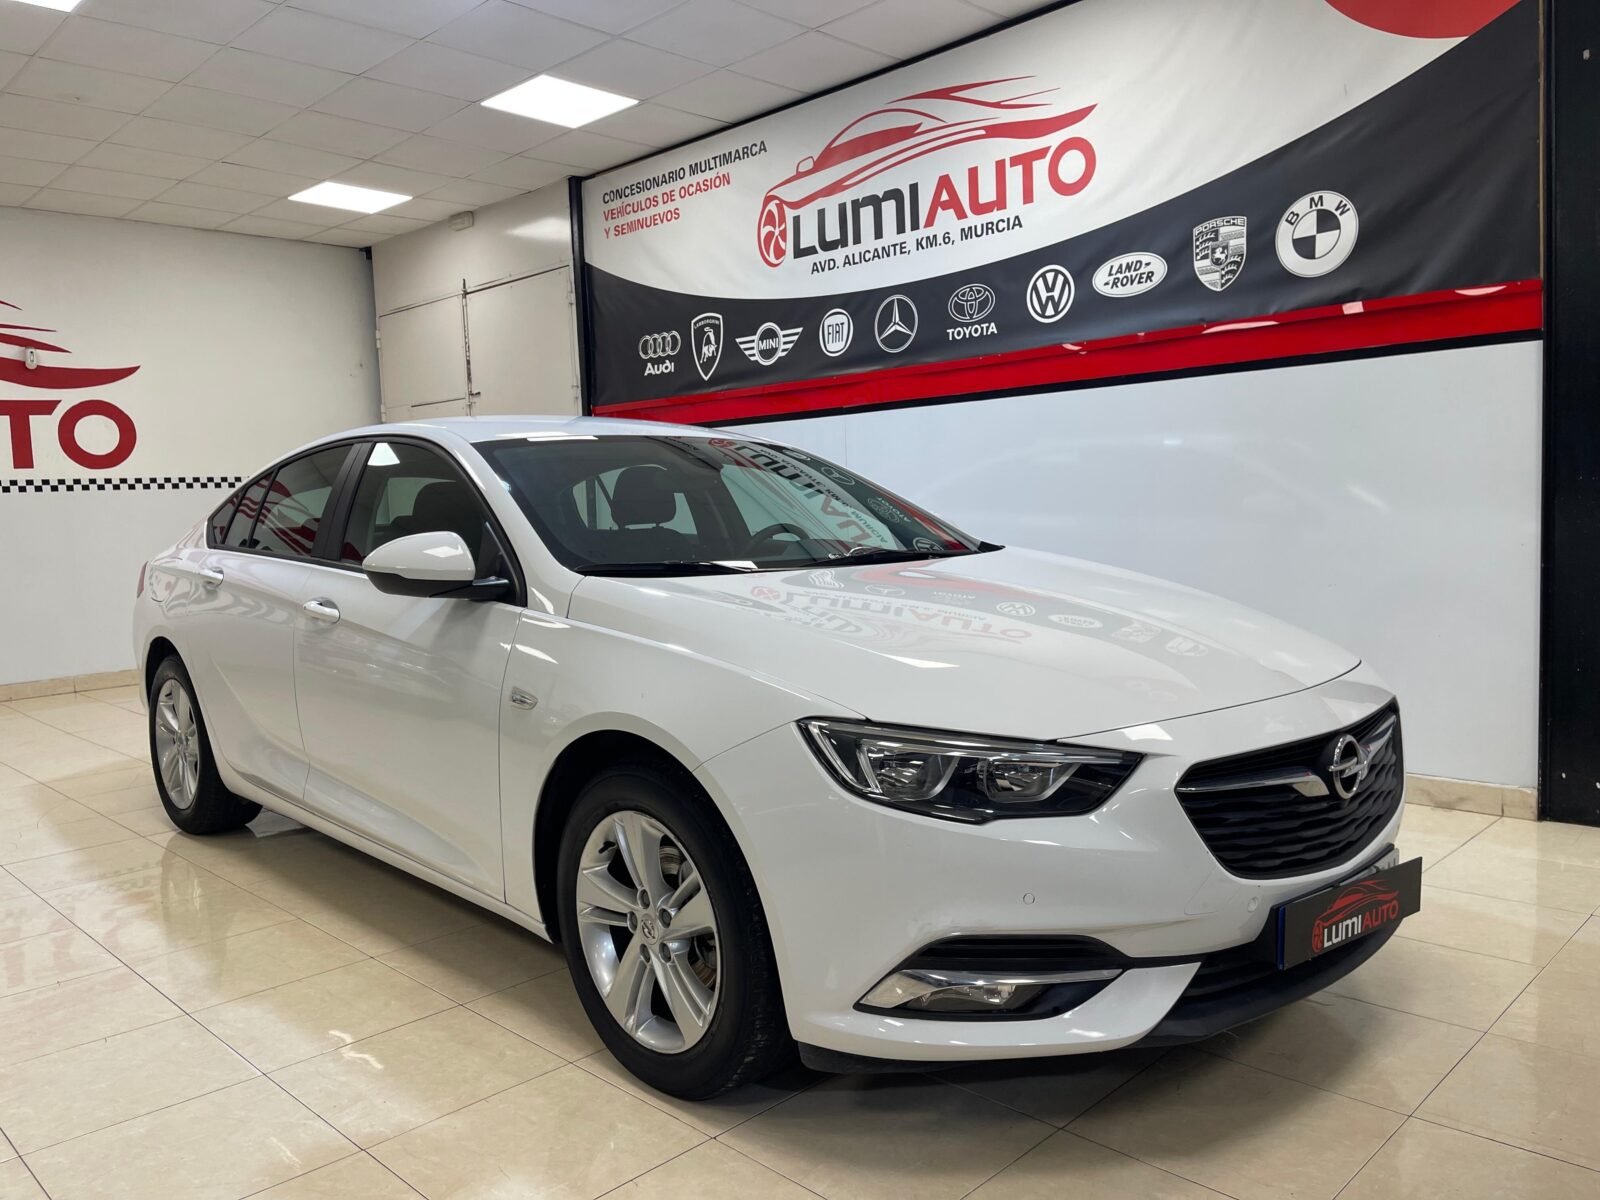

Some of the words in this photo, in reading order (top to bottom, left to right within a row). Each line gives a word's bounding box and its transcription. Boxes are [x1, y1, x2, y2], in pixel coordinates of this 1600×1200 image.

[602, 168, 686, 204] CONCESIONARIO
[689, 140, 768, 177] MULTIMARCA
[603, 195, 659, 222] VEHÍCULOS
[662, 189, 676, 205] DE
[679, 172, 731, 199] OCASIÓN
[604, 227, 611, 239] Y
[613, 208, 681, 237] SEMINUEVOS
[1285, 195, 1351, 226] BMW
[1195, 218, 1245, 236] PORSCHE
[811, 258, 840, 275] AVD.
[843, 241, 911, 267] ALICANTE,
[915, 231, 955, 252] KM.6,
[960, 216, 1023, 241] MURCIA
[758, 337, 779, 351] MINI
[827, 322, 845, 344] FIAT
[946, 322, 998, 341] TOYOTA
[644, 360, 675, 376] Audi
